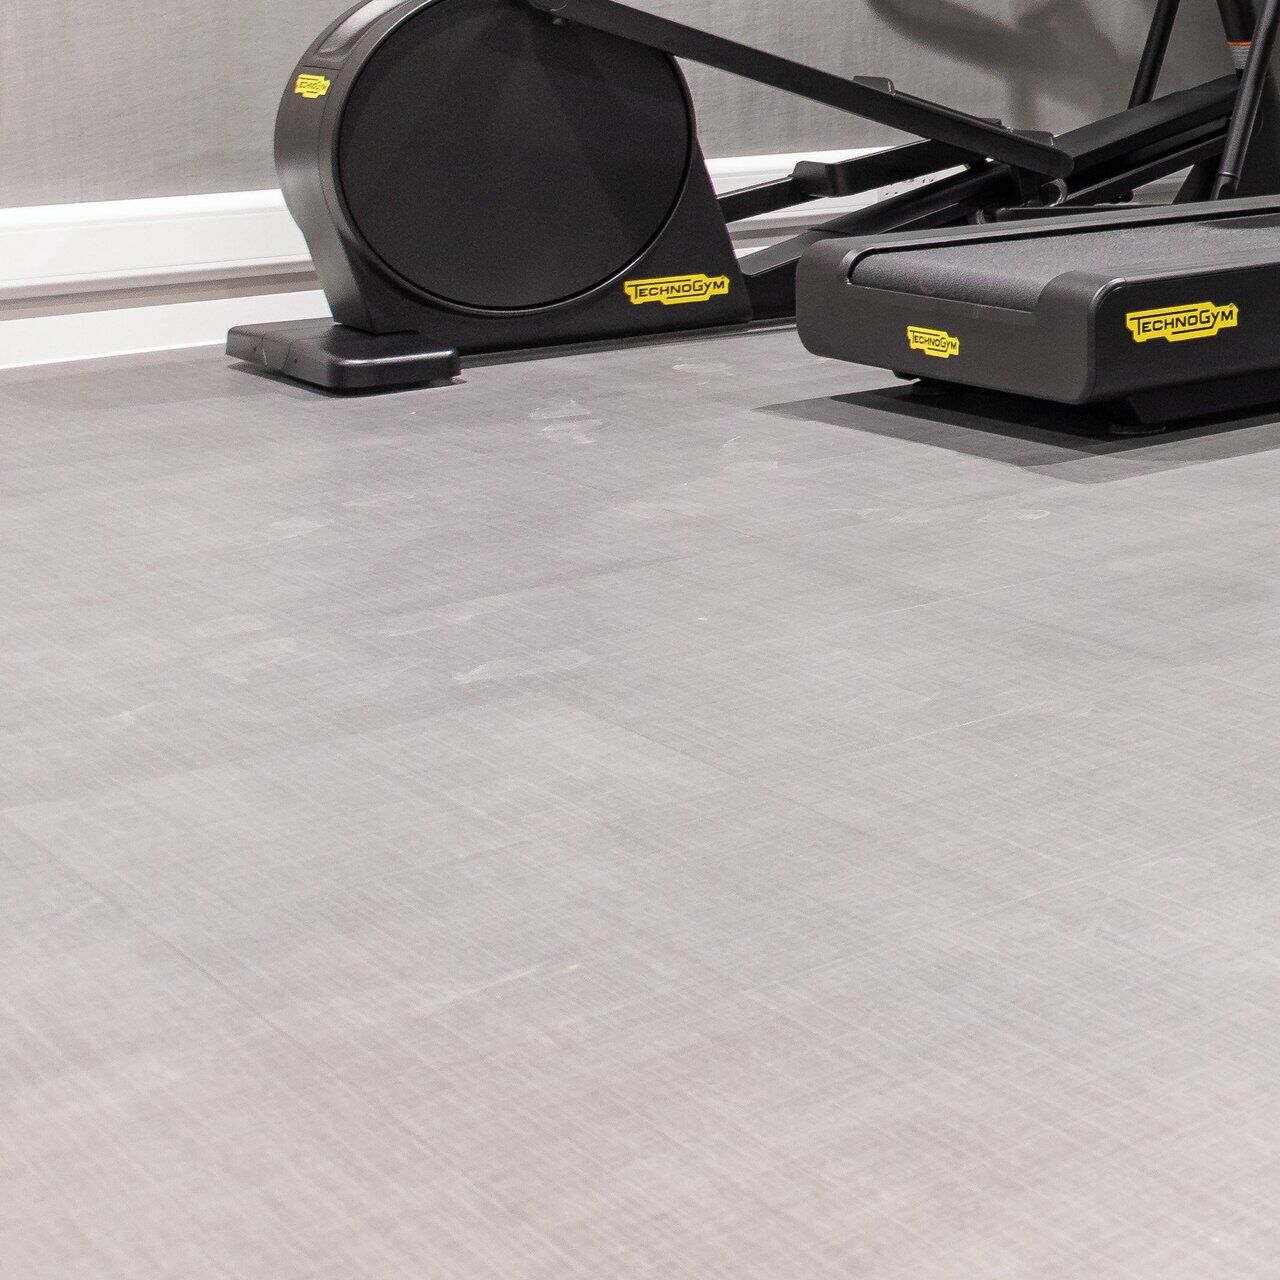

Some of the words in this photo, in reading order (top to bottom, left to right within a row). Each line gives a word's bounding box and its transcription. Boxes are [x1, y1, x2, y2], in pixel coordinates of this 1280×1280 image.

[627, 278, 726, 300] TECHNOGYM
[1129, 308, 1234, 335] TECHNOGYM
[909, 329, 958, 352] TECHNOGYM
